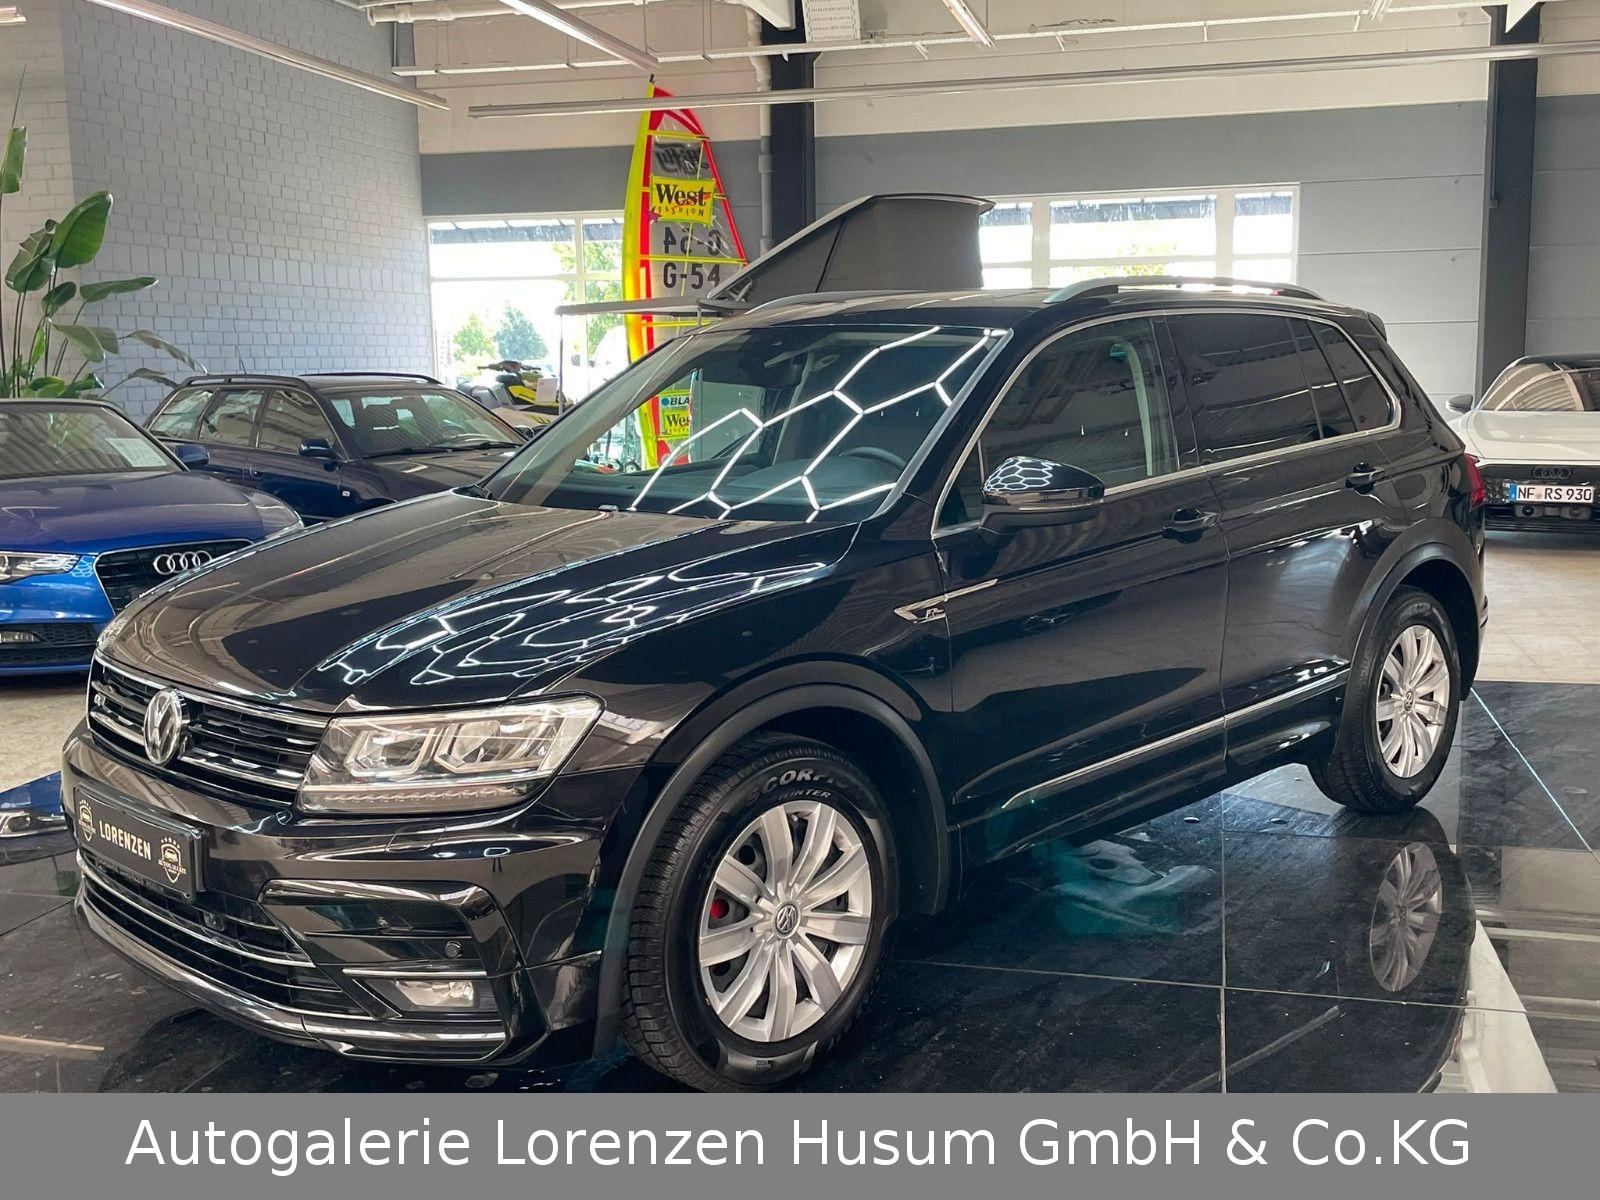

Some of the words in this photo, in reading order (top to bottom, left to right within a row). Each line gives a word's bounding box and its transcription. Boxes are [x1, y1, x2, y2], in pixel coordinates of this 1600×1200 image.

[655, 183, 706, 207] West
[652, 205, 704, 217] FASHION
[663, 262, 721, 289] G-54
[670, 397, 690, 406] BLA
[666, 413, 690, 428] Wes
[1518, 487, 1535, 499] NF
[1544, 488, 1562, 500] RS
[1566, 488, 1592, 501] 930
[99, 820, 151, 860] LORENZEN
